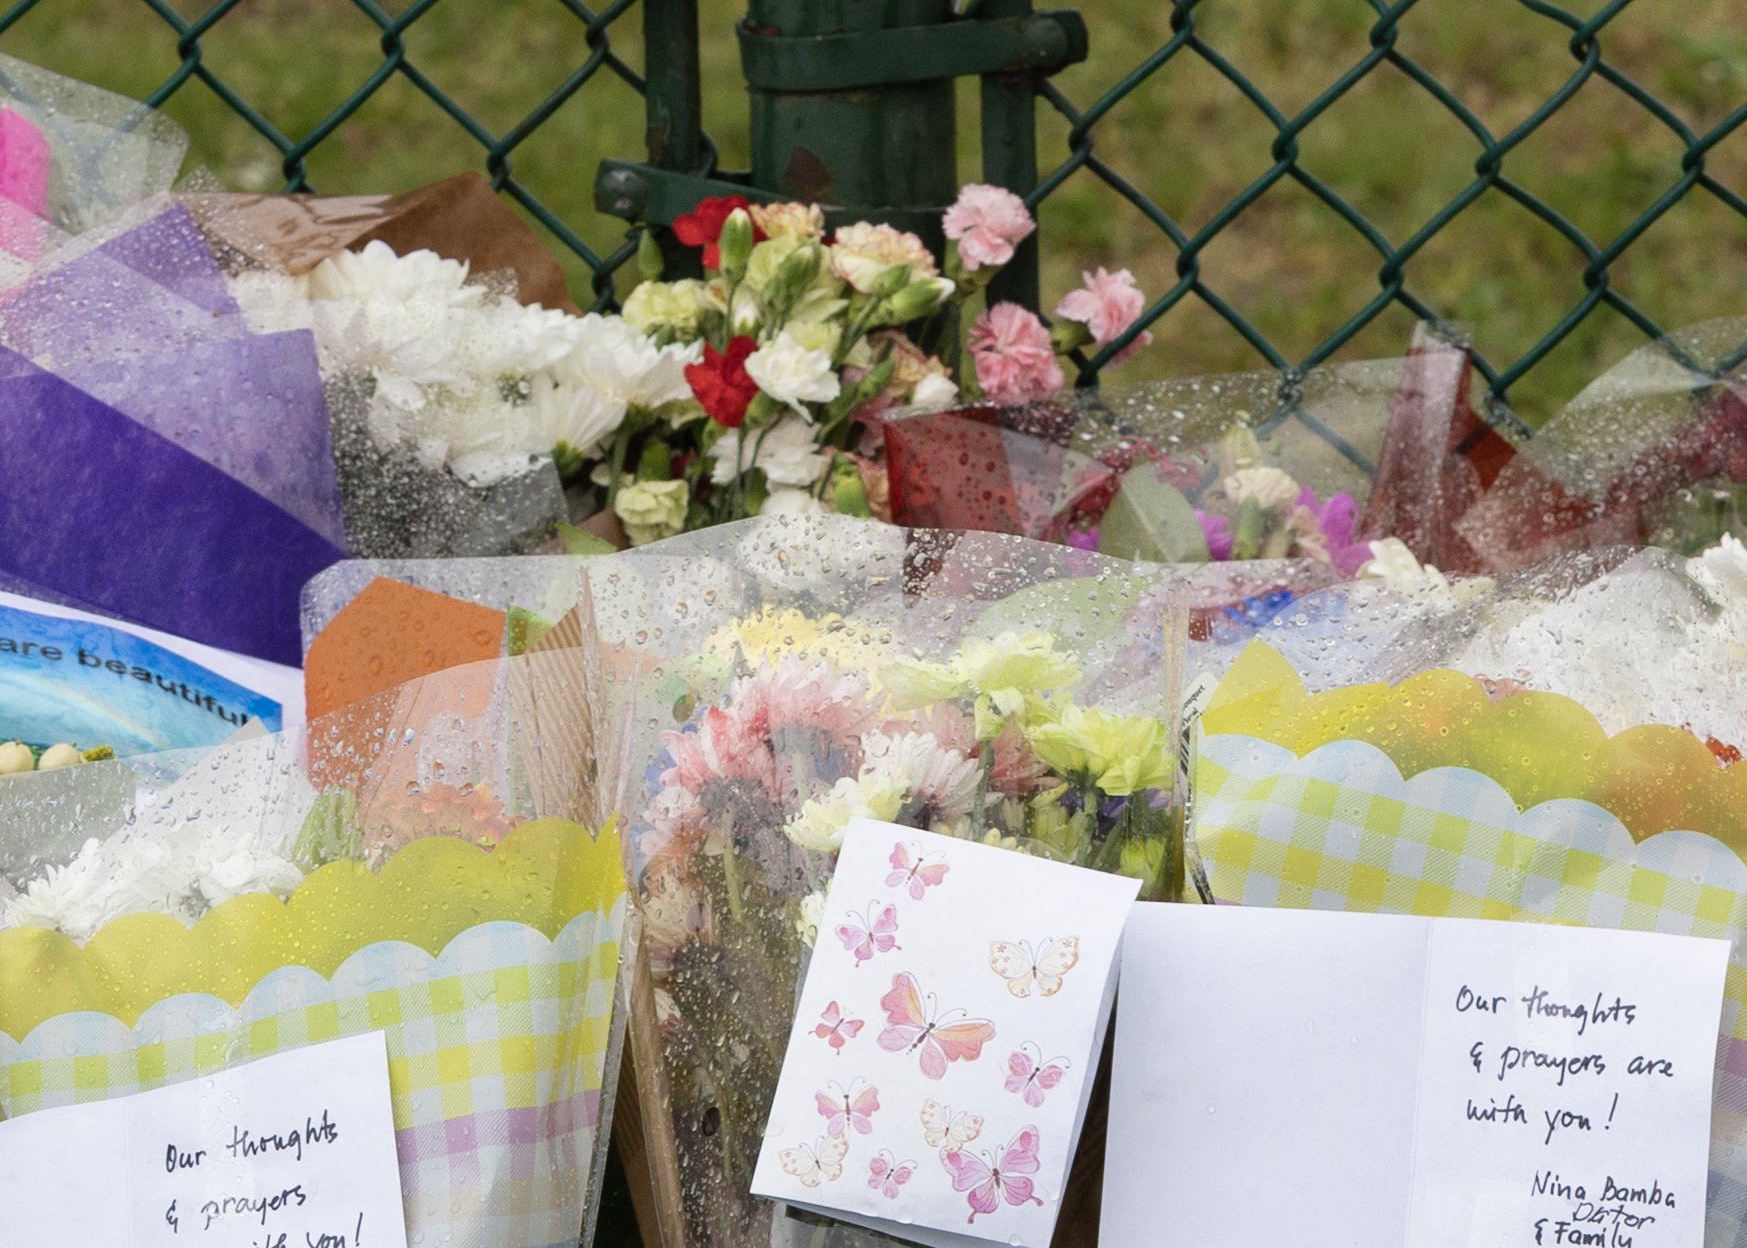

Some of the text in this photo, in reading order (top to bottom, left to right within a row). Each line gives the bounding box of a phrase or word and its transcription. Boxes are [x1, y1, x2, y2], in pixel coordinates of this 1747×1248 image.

[78, 647, 248, 728] beautiful
[1456, 985, 1637, 1036] Our thoughts
[1498, 1045, 1606, 1087] prayers
[1627, 1054, 1674, 1078] are
[1466, 1094, 1528, 1124] with
[165, 1109, 339, 1173] Our thoughts
[201, 1184, 307, 1231] prayers
[1531, 1170, 1676, 1209] Nina Bamba
